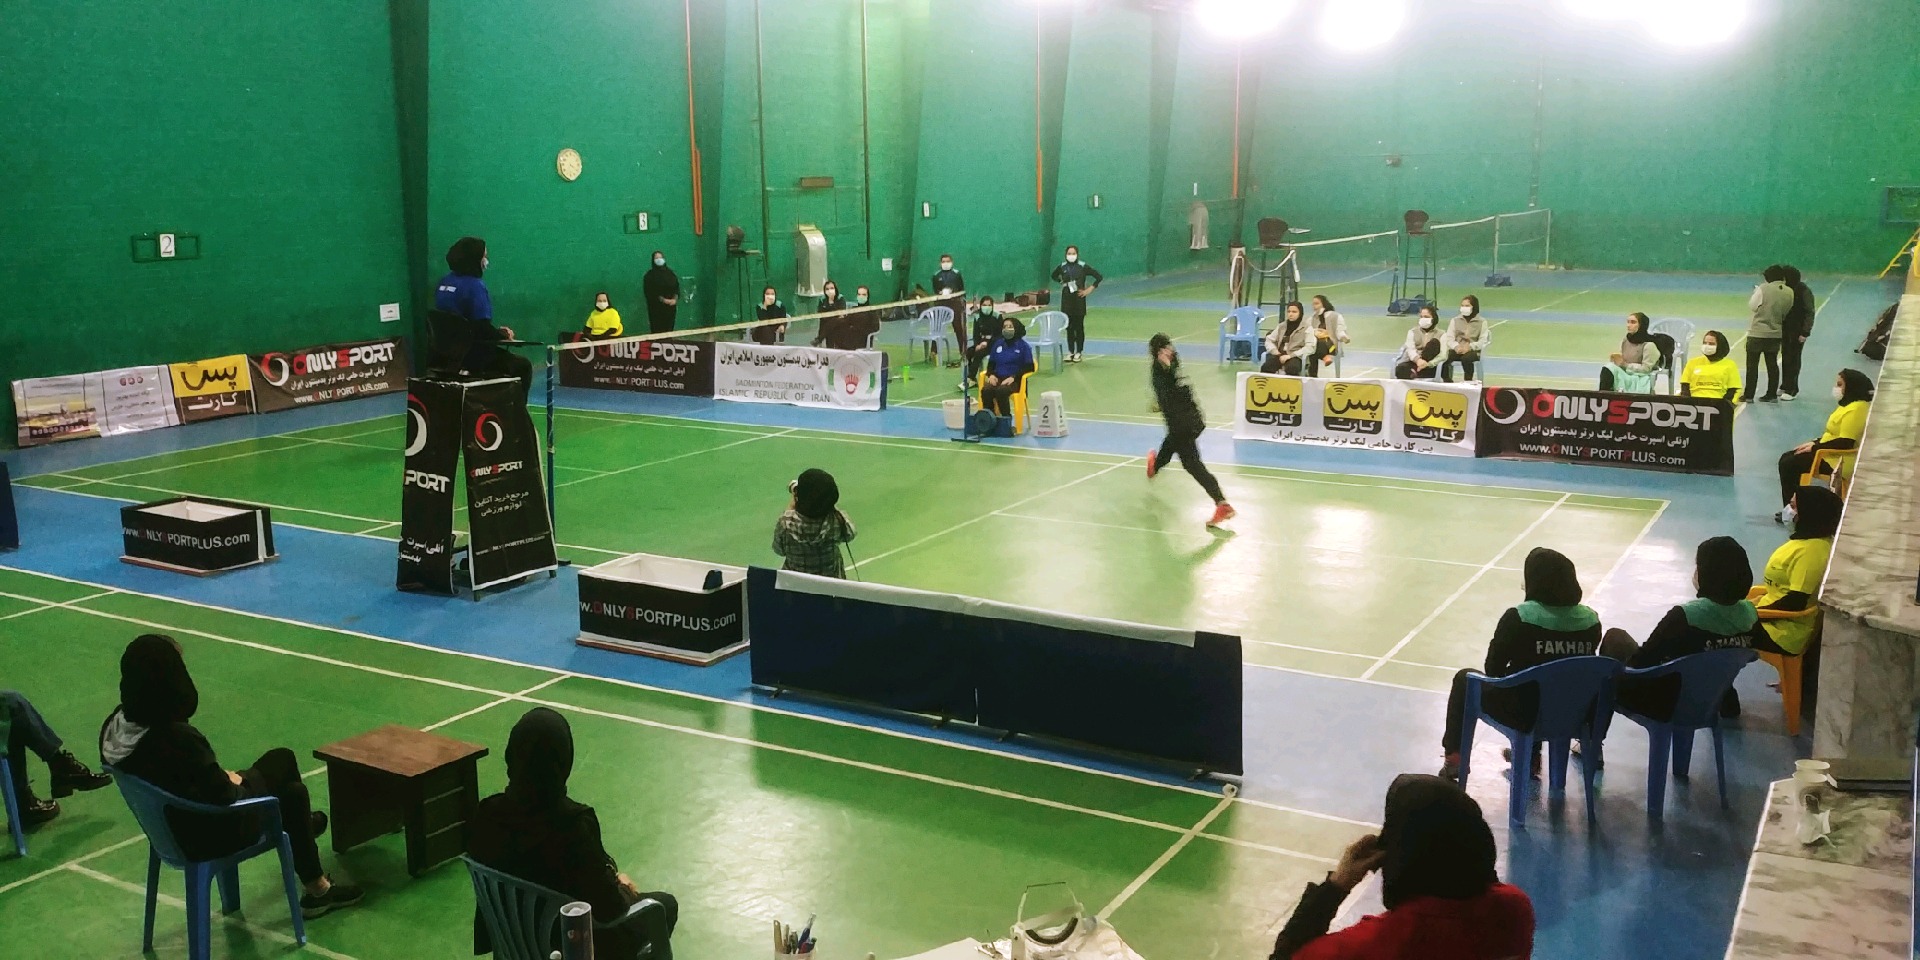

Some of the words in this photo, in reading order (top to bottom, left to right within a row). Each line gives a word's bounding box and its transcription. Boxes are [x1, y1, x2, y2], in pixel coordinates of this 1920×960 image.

[162, 235, 173, 255] 2
[293, 341, 395, 375] ONLYSPORT
[597, 341, 700, 364] ONLYSPORT
[181, 366, 237, 391] پس
[593, 376, 685, 390] www.NLYPORTLUS.com
[187, 391, 238, 411] کارت
[718, 388, 750, 398] ISLAMIC
[753, 389, 788, 401] REPUBLIC
[794, 392, 806, 401] OF
[811, 393, 831, 403] IRAN
[1250, 389, 1300, 412] پس
[1042, 405, 1049, 418] 2
[1326, 397, 1381, 418] پس
[1532, 392, 1720, 431] ONLYSPORT
[1250, 412, 1296, 426] کارت
[1409, 403, 1464, 428] پس
[1328, 418, 1376, 434] کارت
[1409, 426, 1459, 440] کارت
[1519, 423, 1542, 435] ایران
[1541, 426, 1578, 438] بدمینتون
[1271, 429, 1293, 440] ایران
[1578, 428, 1595, 440] برتر
[1596, 429, 1614, 440] لیگ
[1614, 431, 1638, 442] حامی
[1639, 435, 1666, 446] اسپرت
[1367, 438, 1392, 449] حامی
[1393, 441, 1417, 453] کارت
[1667, 436, 1690, 449] اونلی
[1519, 443, 1686, 466] www.ONLYSPORTPLUS.com
[470, 461, 523, 478] ONLYSPORT
[404, 469, 451, 493] PORT
